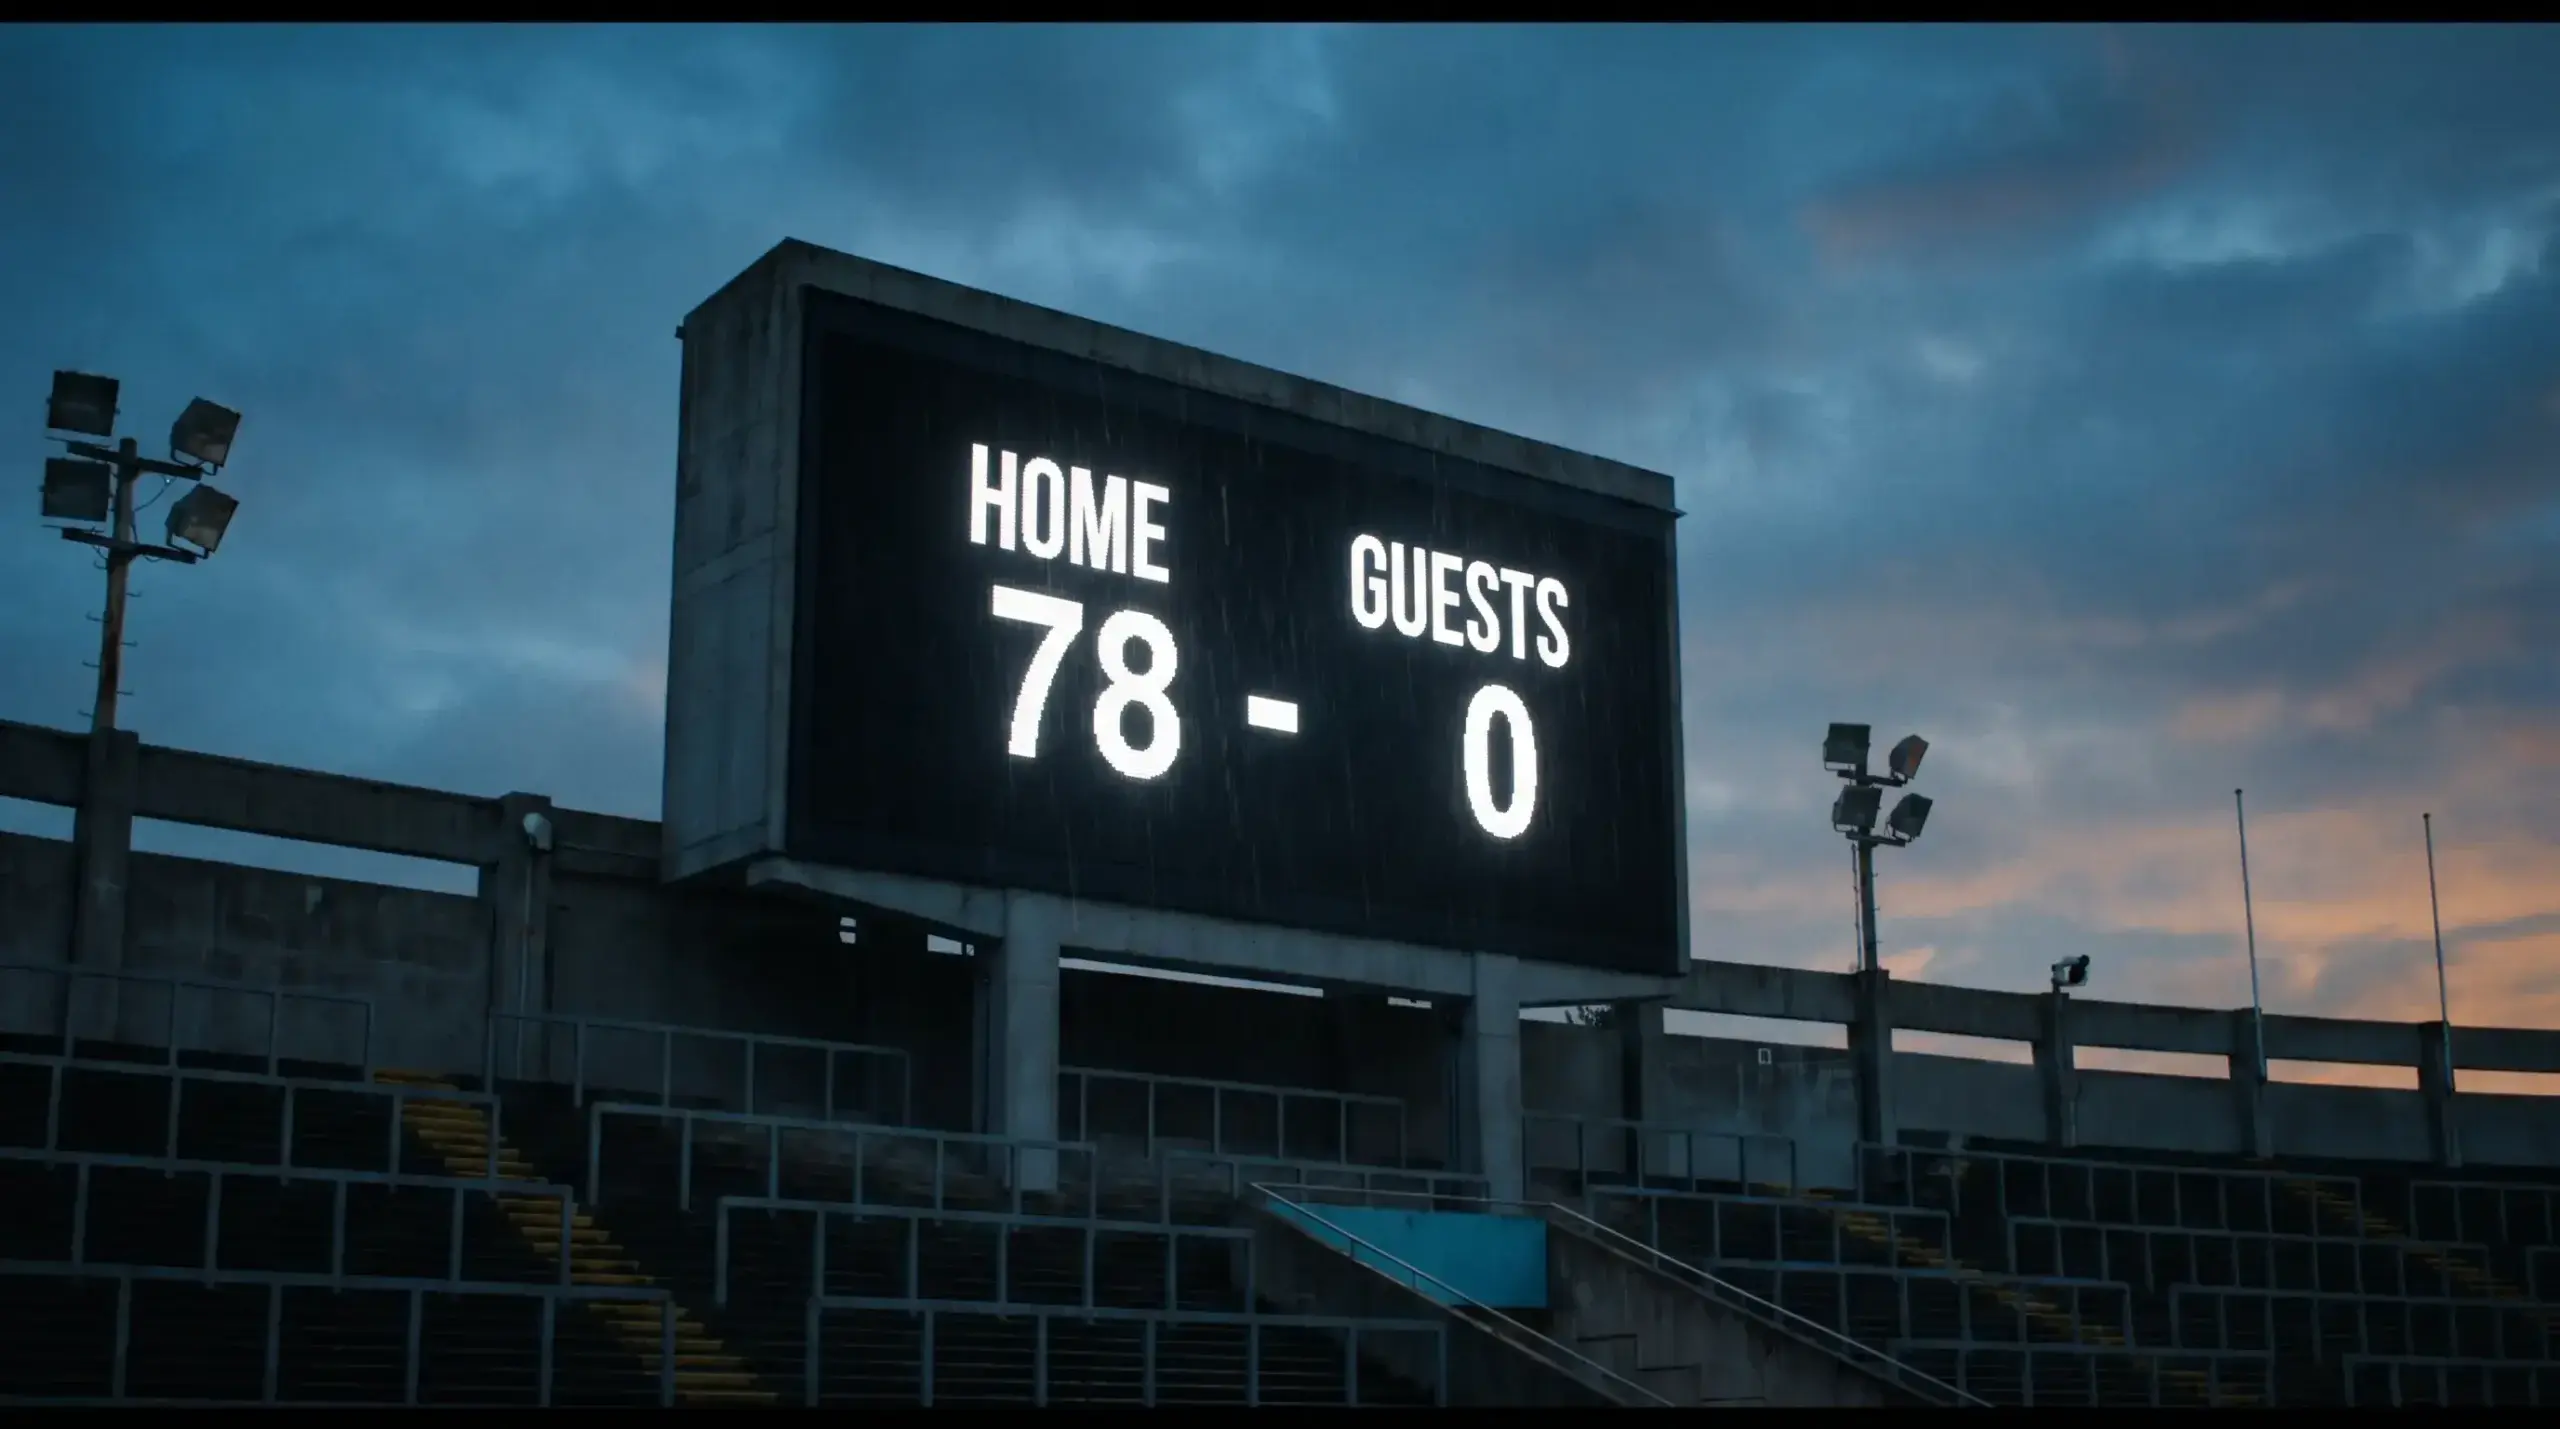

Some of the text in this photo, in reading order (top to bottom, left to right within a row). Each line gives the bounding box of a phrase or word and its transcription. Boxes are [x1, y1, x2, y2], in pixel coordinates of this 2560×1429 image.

[970, 443, 1570, 668] HOME GUESTS
[992, 584, 1538, 839] 78 - 0
